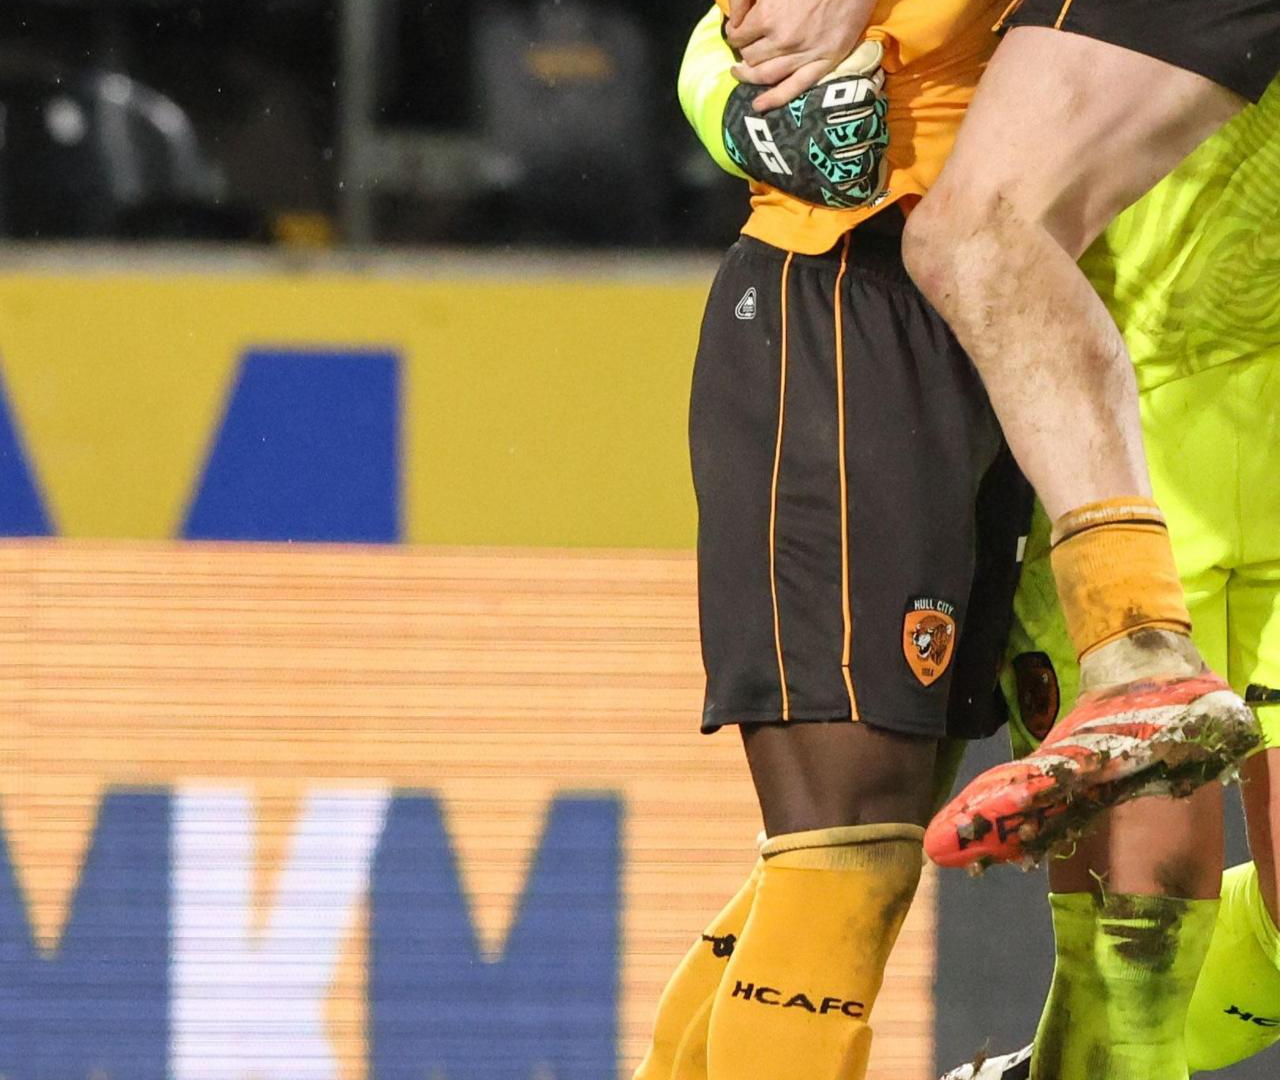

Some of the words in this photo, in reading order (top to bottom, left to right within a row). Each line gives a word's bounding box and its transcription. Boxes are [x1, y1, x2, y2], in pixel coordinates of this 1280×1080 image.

[914, 599, 934, 611] HULL
[936, 600, 954, 615] CITY
[731, 980, 866, 1018] HCAFC
